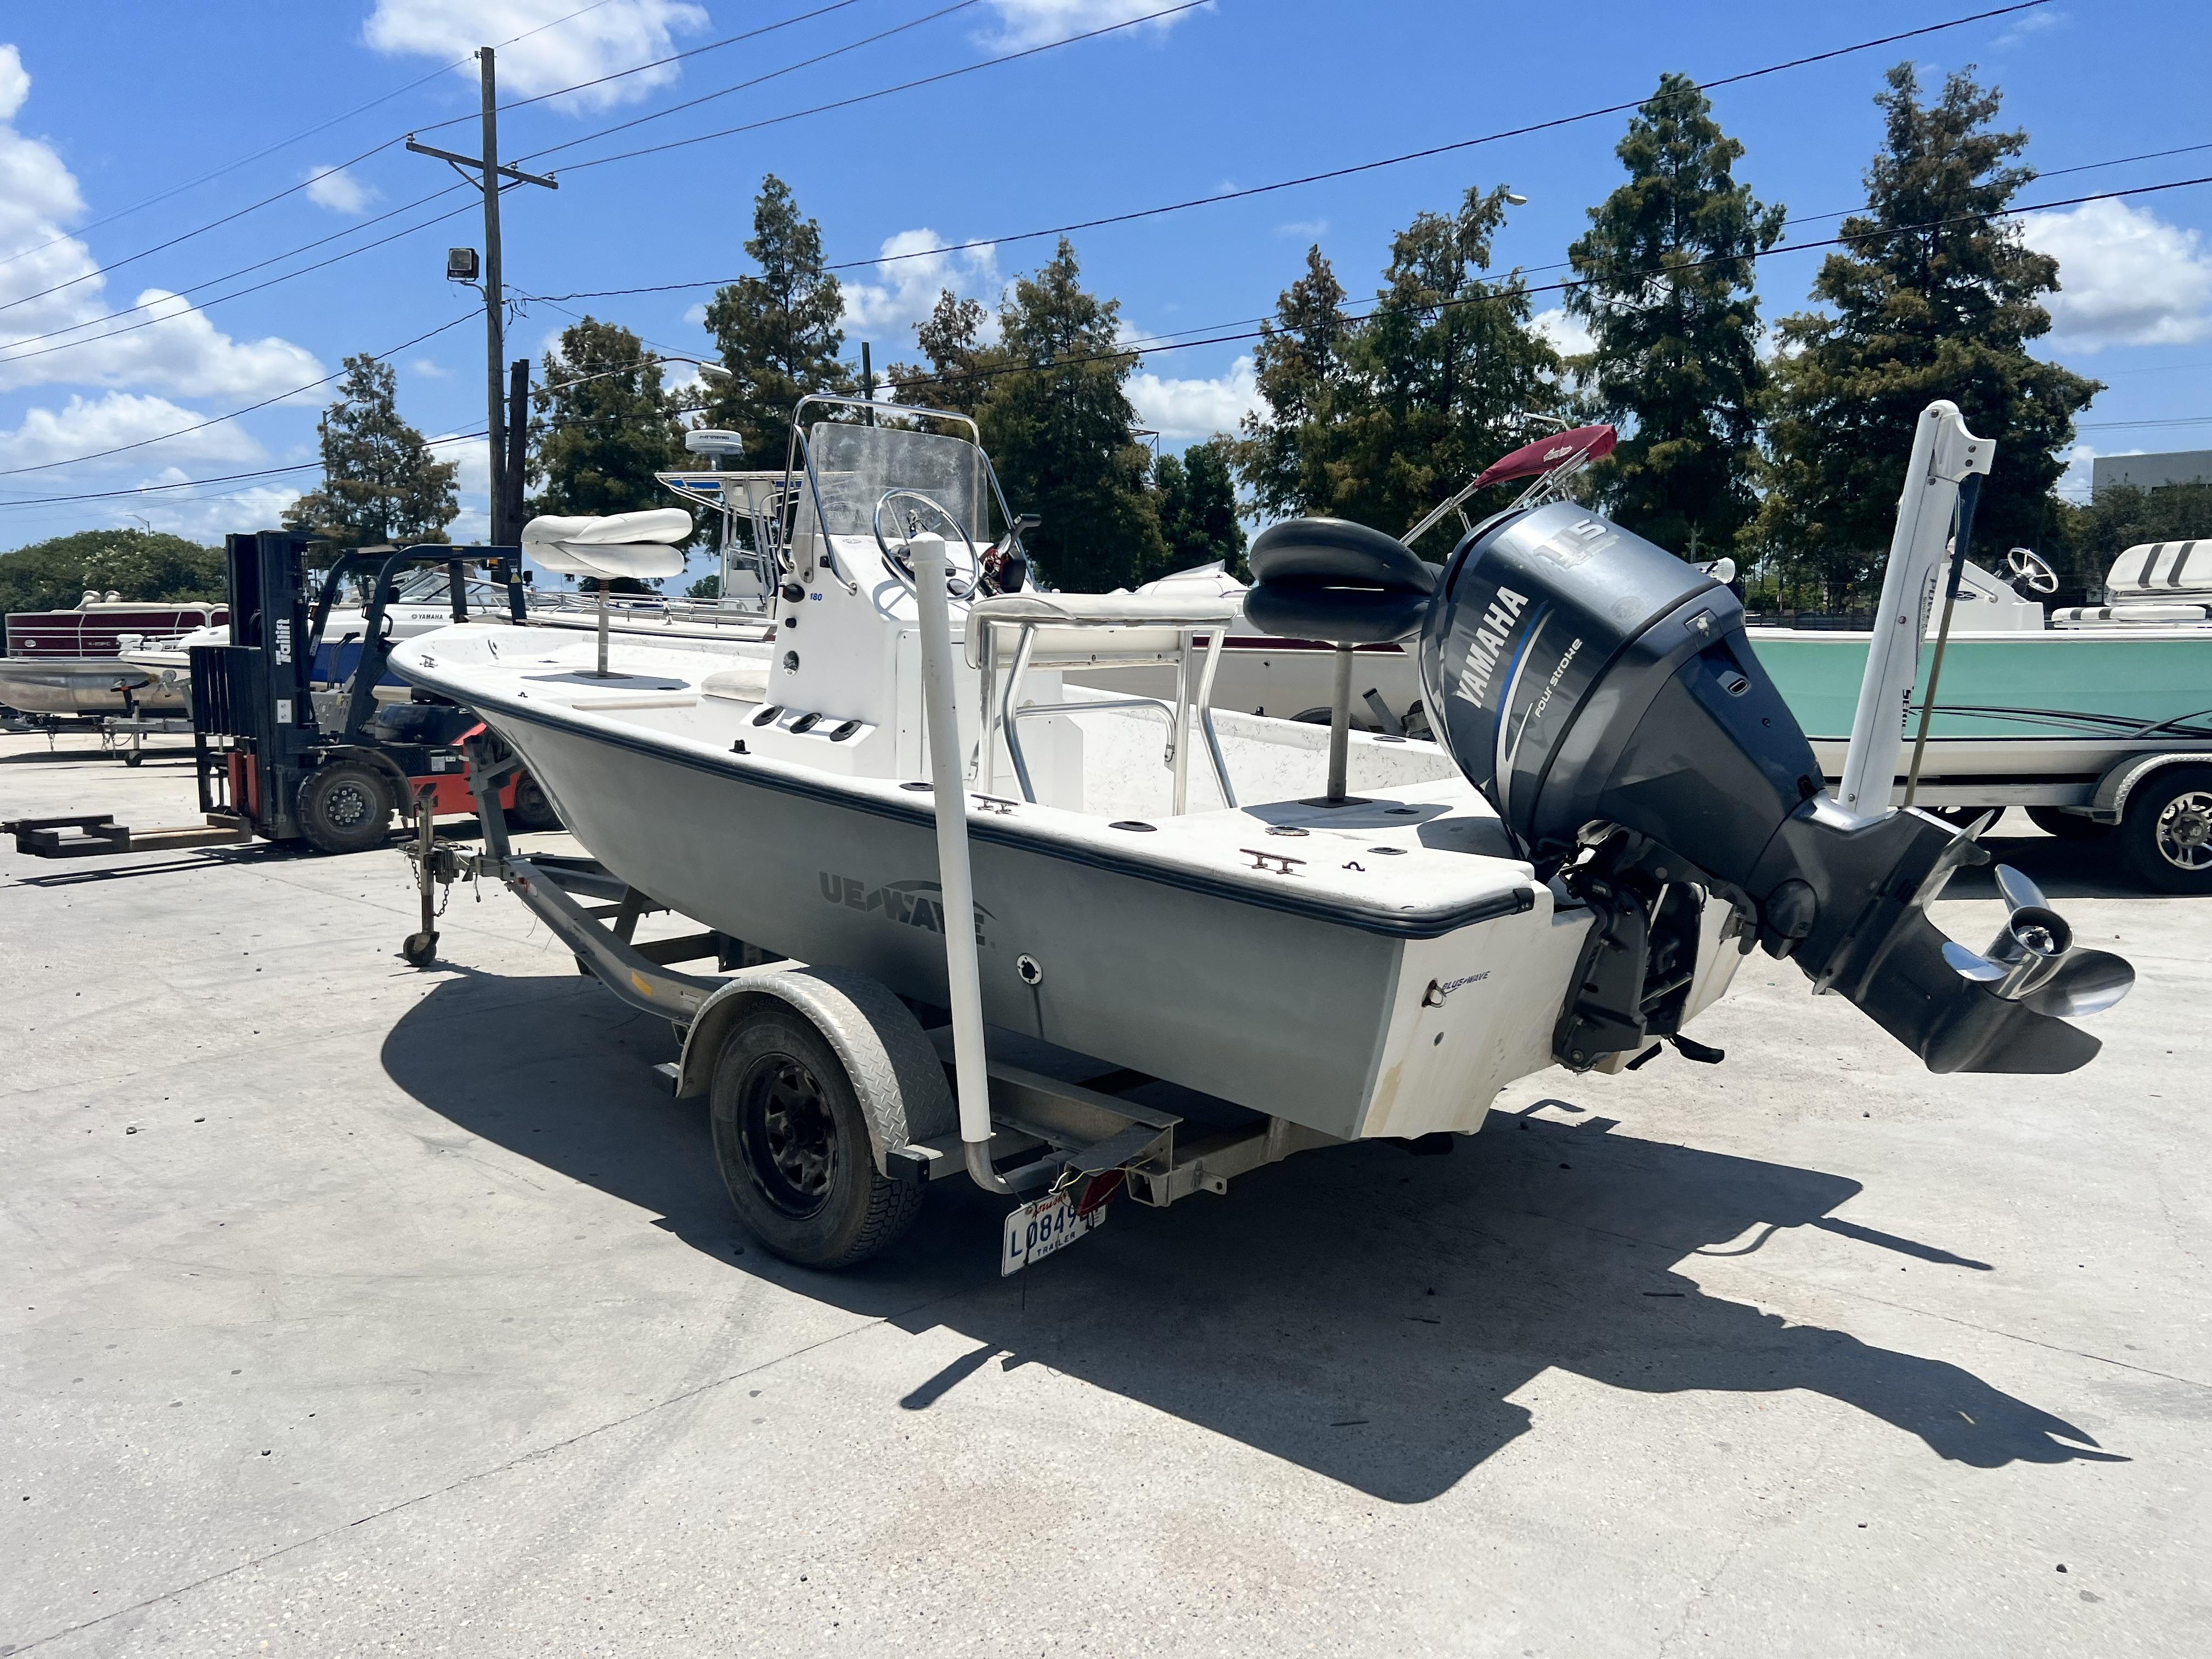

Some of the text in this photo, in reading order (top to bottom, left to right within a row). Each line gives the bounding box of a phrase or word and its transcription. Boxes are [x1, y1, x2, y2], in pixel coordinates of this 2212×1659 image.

[810, 592, 822, 601] 180
[275, 618, 291, 665] Tailift
[1456, 586, 1529, 709] YAMAHA
[1442, 970, 1491, 990] BLUE WAVE
[1011, 1203, 1087, 1257] L0849
[1036, 1231, 1076, 1257] TRAILER
